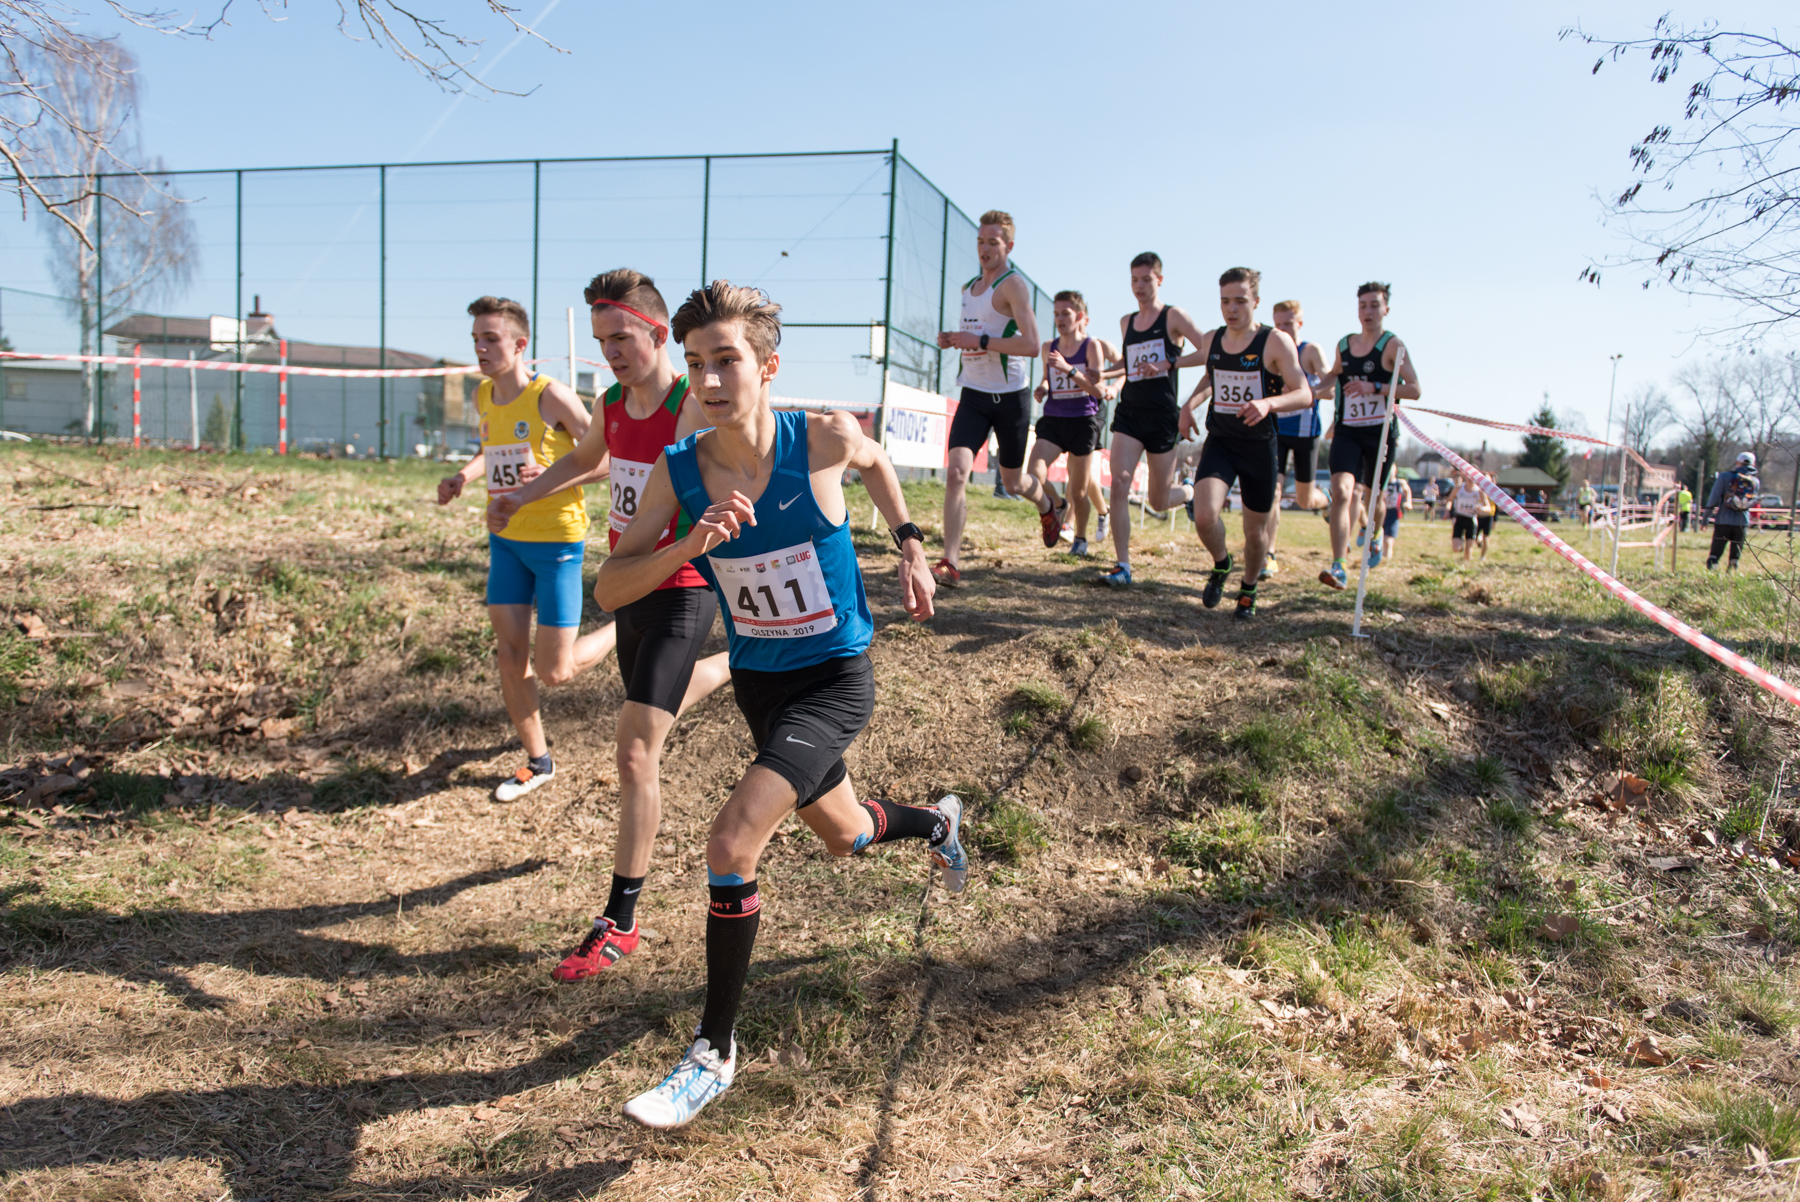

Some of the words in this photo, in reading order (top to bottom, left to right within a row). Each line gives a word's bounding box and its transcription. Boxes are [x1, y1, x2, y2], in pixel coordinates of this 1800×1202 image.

[1220, 384, 1254, 403] 356
[1350, 401, 1379, 418] 317
[795, 550, 812, 563] LUG
[737, 578, 807, 618] 411
[751, 628, 789, 637] OLSZYNA
[793, 625, 815, 636] 2019
